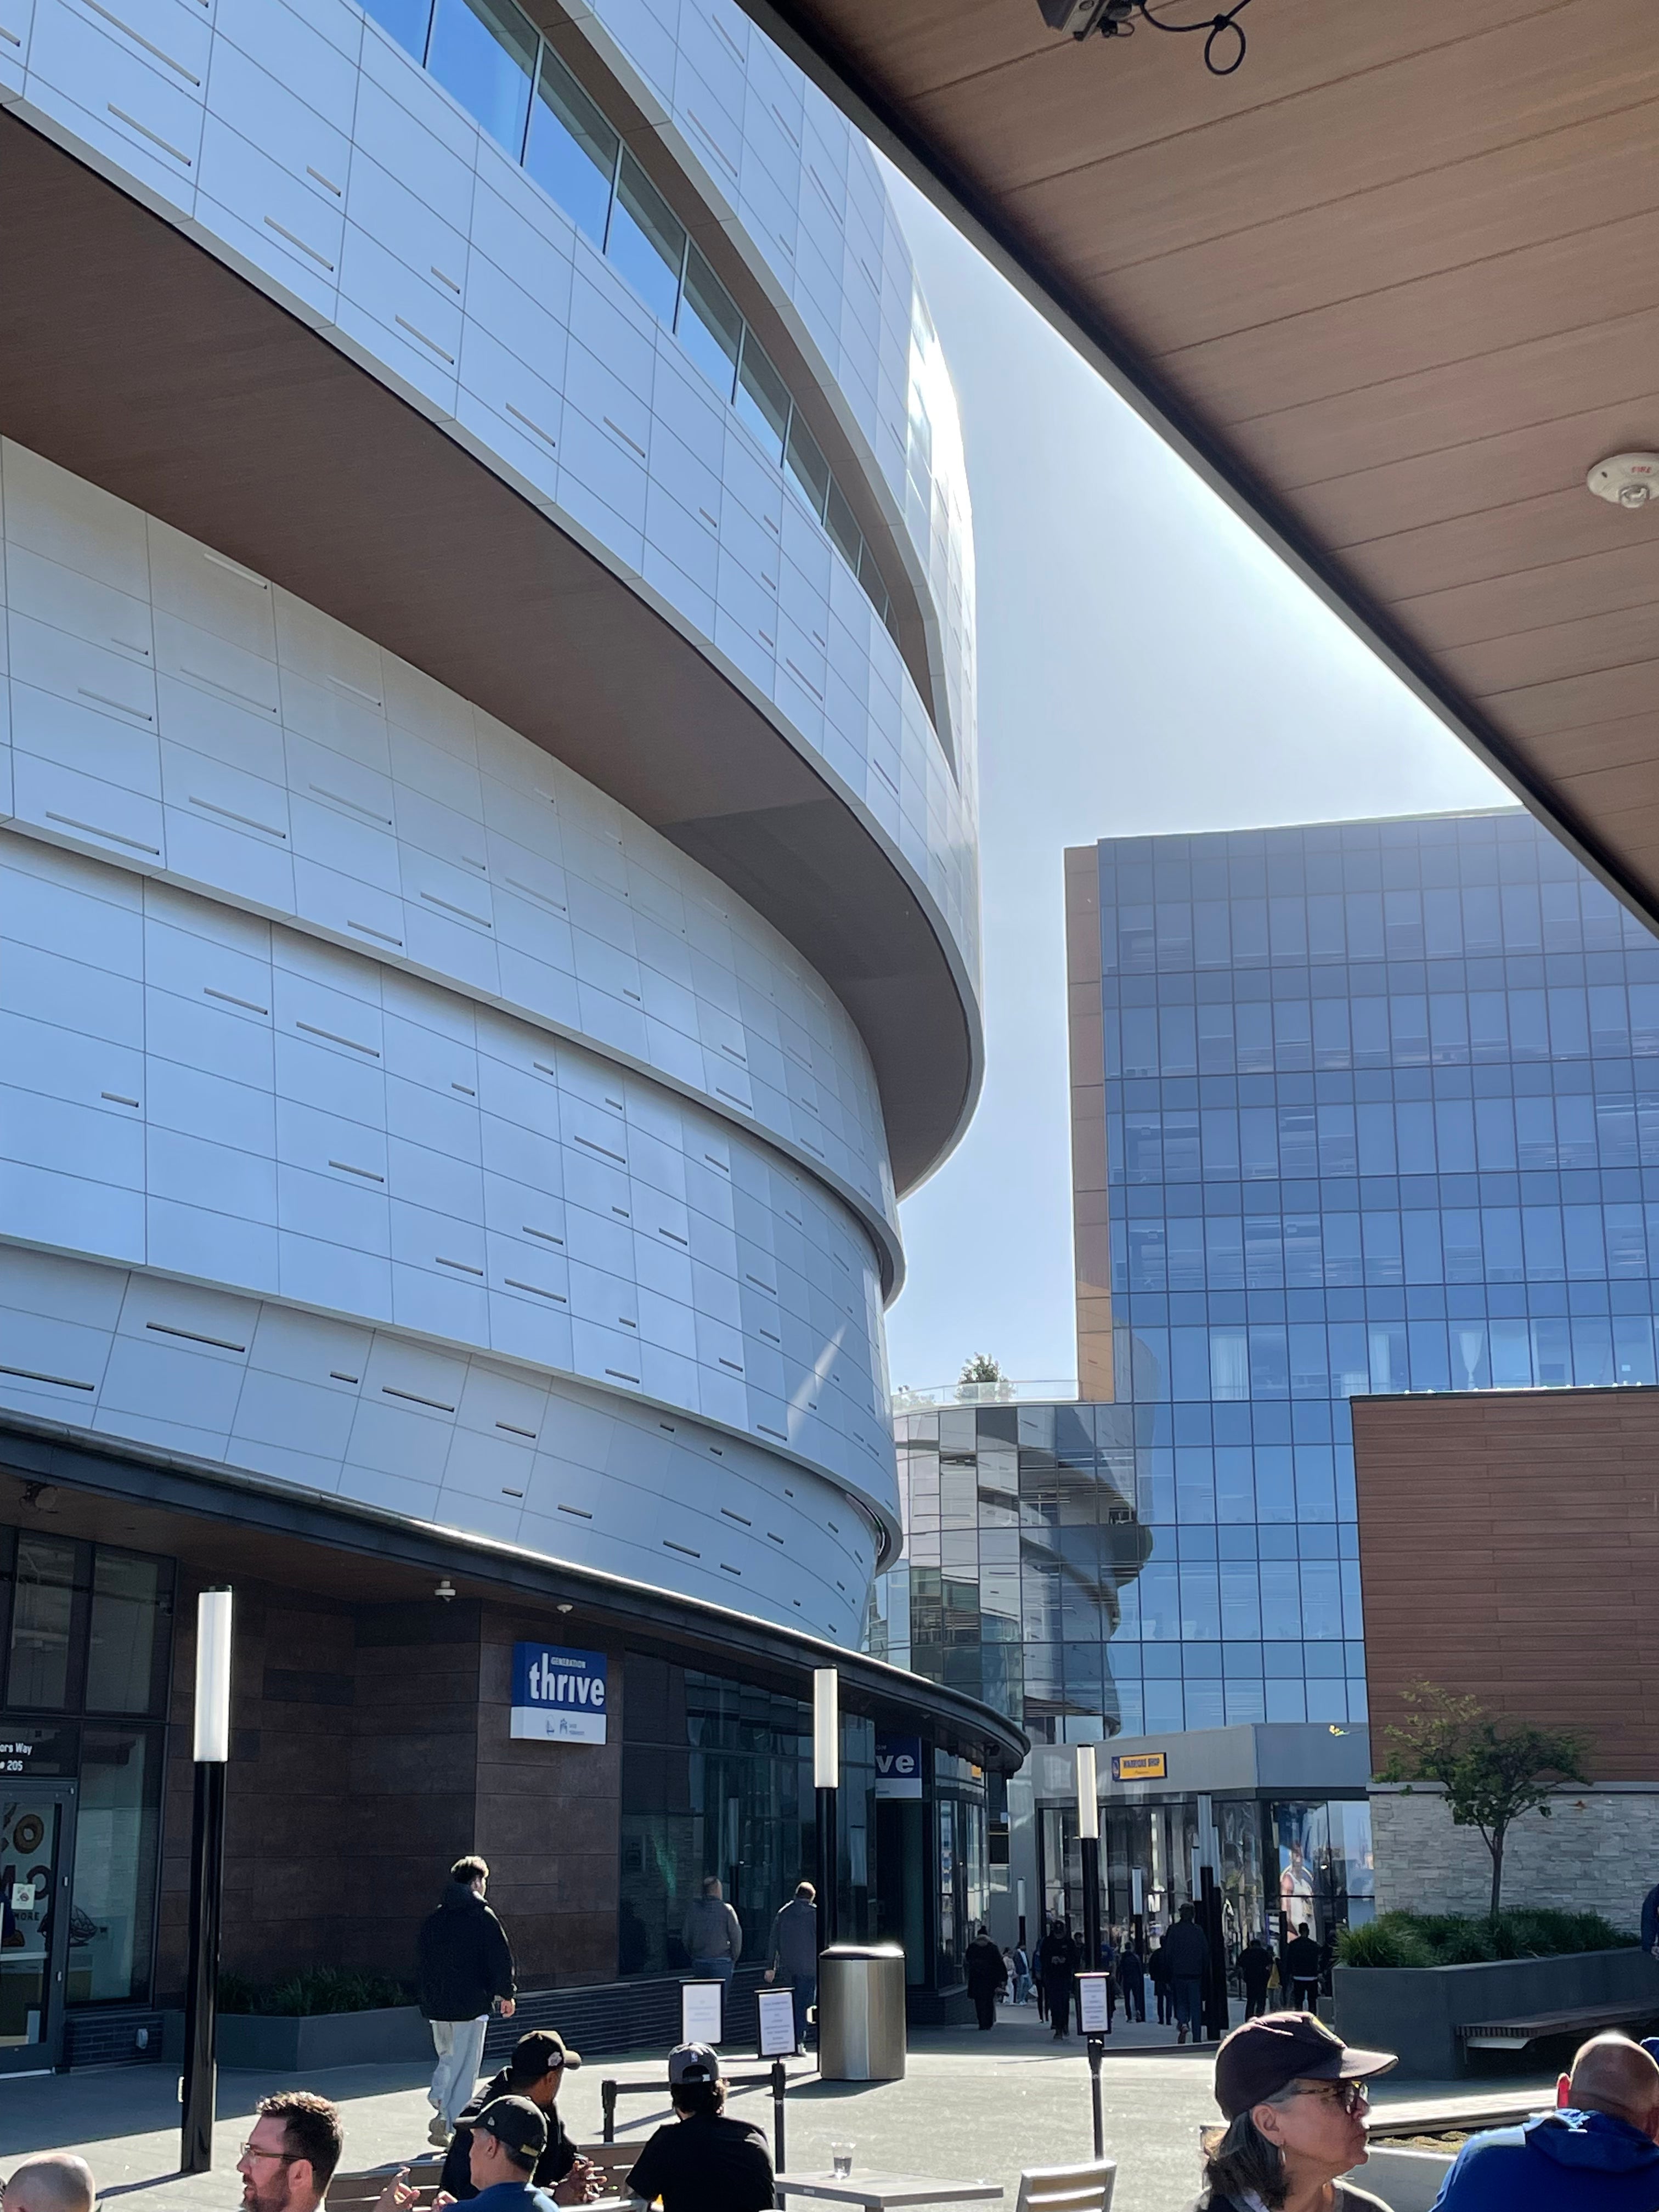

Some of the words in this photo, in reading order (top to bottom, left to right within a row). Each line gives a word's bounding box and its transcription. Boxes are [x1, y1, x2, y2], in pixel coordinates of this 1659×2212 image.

[529, 1652, 605, 1706] thrive
[15, 1742, 33, 1756] Way
[7, 1760, 23, 1771] 205
